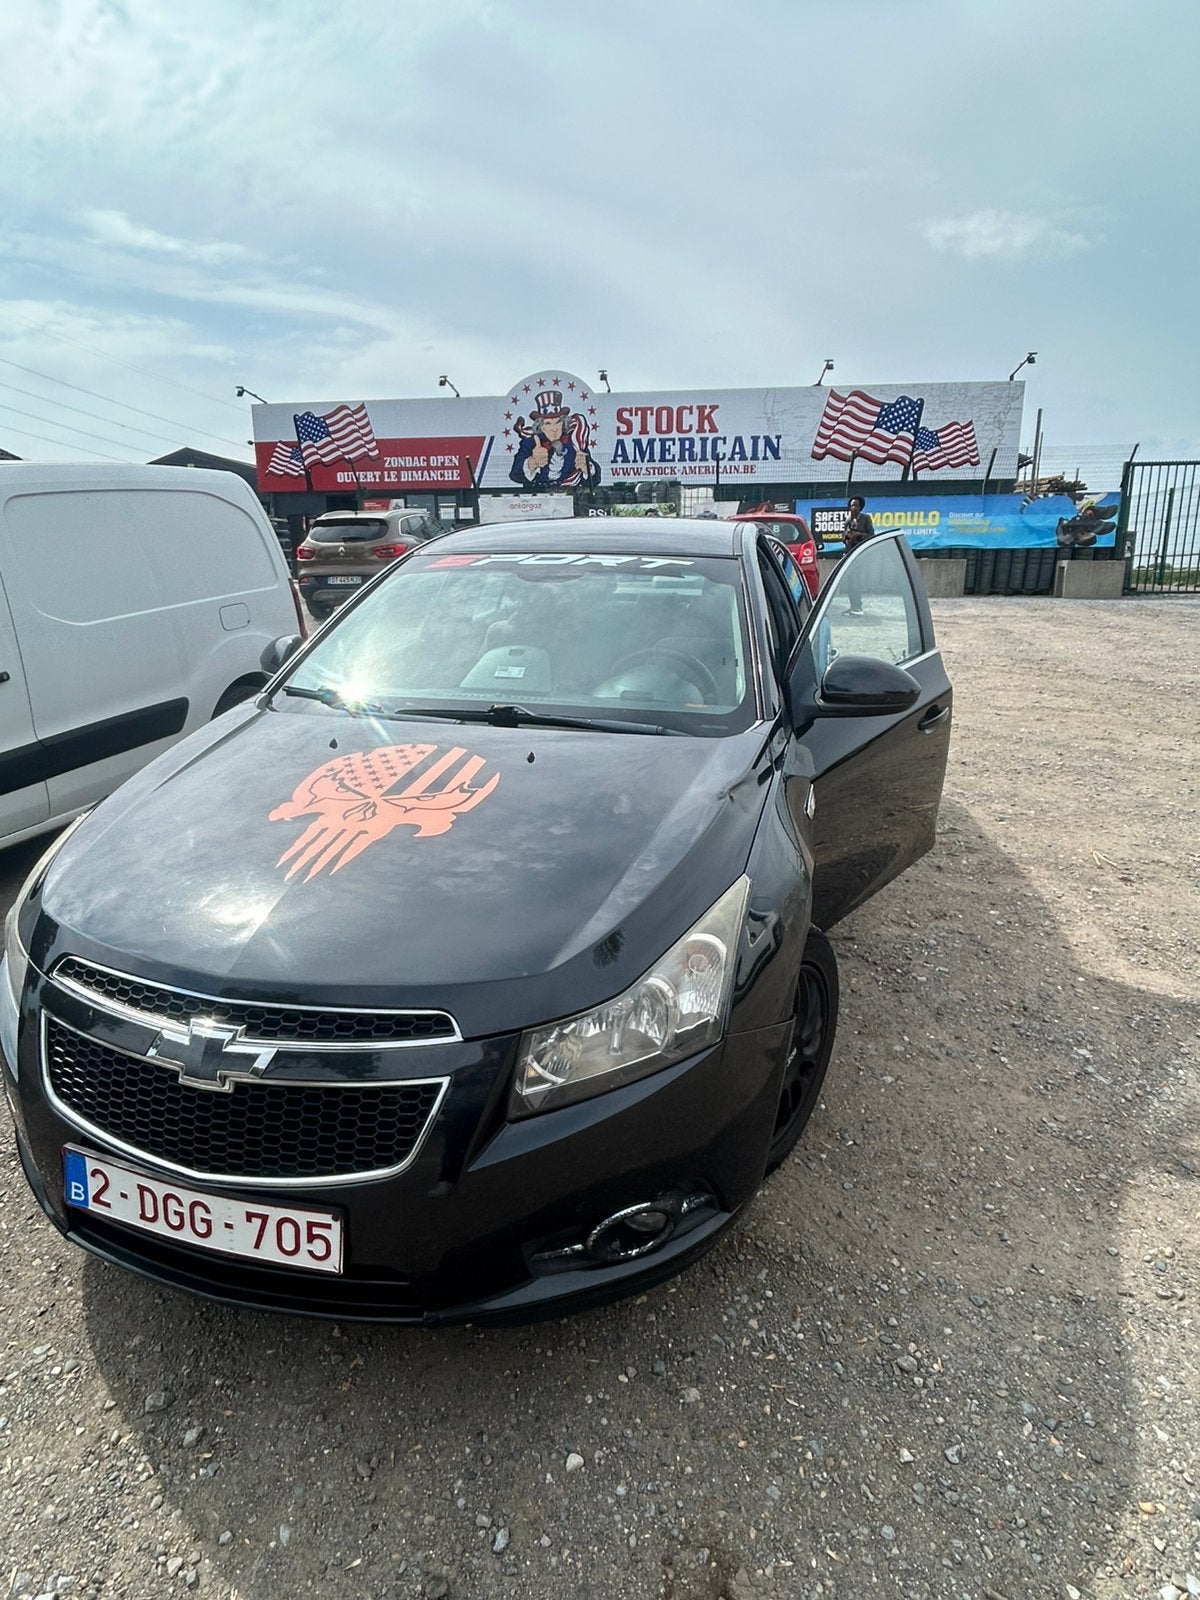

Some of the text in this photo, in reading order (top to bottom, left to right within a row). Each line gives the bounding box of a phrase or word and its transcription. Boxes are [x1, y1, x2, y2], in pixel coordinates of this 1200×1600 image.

[616, 405, 720, 436] STOCK
[610, 434, 782, 464] AMERICAIN
[384, 455, 460, 468] ZONDAG OPEN
[336, 469, 460, 483] OUVERT LE DIMANCHE
[611, 464, 757, 477] WWW.STOCK-AMERICAIN.BE
[815, 511, 852, 522] SAFETY
[870, 511, 940, 527] MODULO
[814, 521, 848, 532] JOGGE
[424, 554, 695, 569] SPORT
[71, 1183, 84, 1201] B
